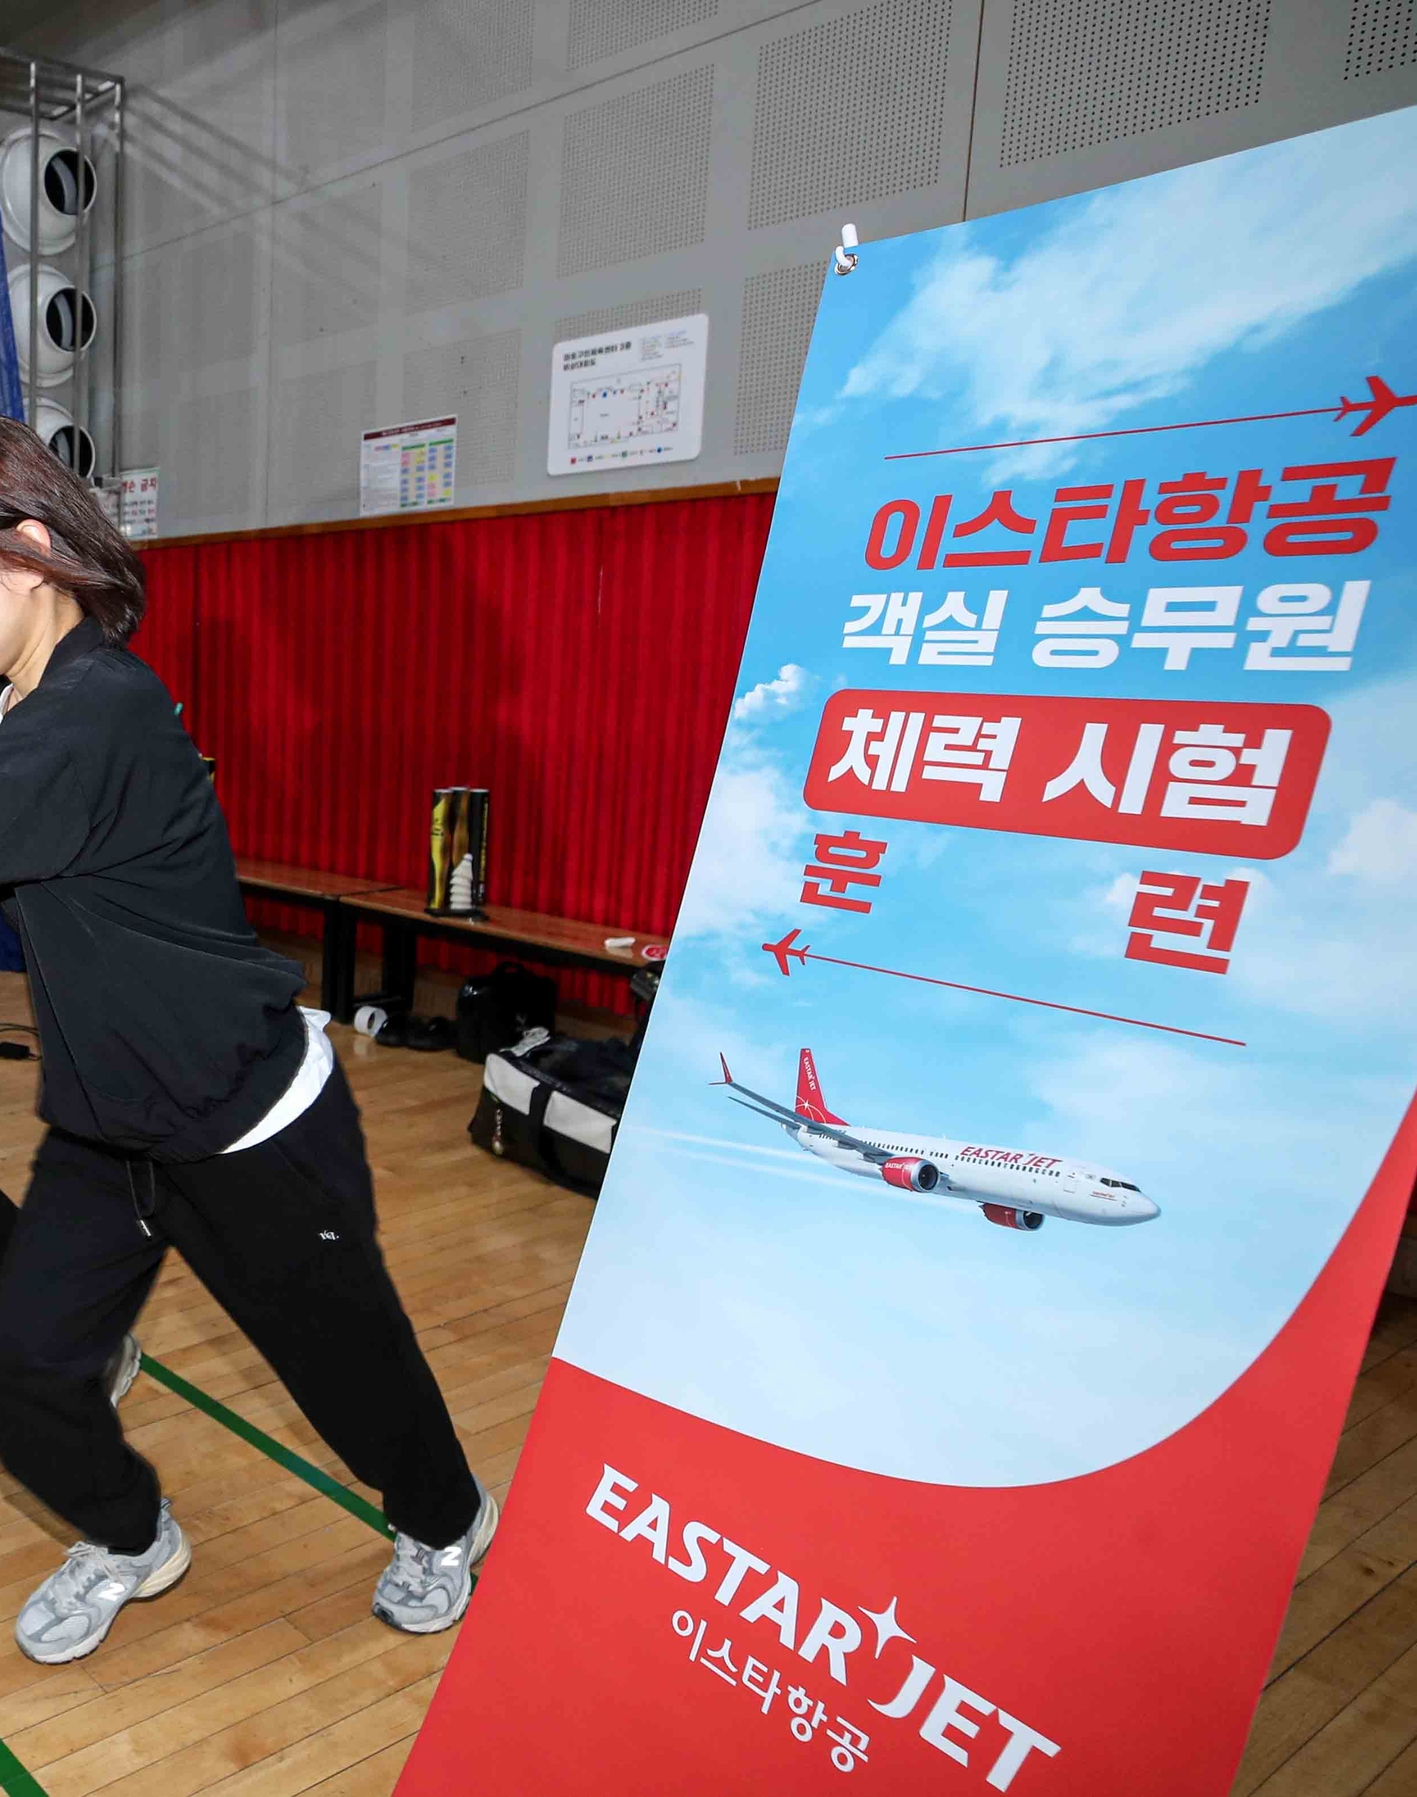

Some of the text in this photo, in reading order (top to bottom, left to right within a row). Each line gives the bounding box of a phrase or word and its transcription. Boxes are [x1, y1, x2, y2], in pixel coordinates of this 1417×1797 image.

[864, 456, 1397, 571] 이스타항공
[841, 580, 1372, 671] 객실 승무원
[826, 708, 1293, 827] 체력 시험
[800, 830, 1251, 975] 훈 련
[960, 1146, 1063, 1169] EASTAR JET
[585, 1463, 1062, 1793] EASTAR JET
[670, 1608, 870, 1774] 이스타항공
